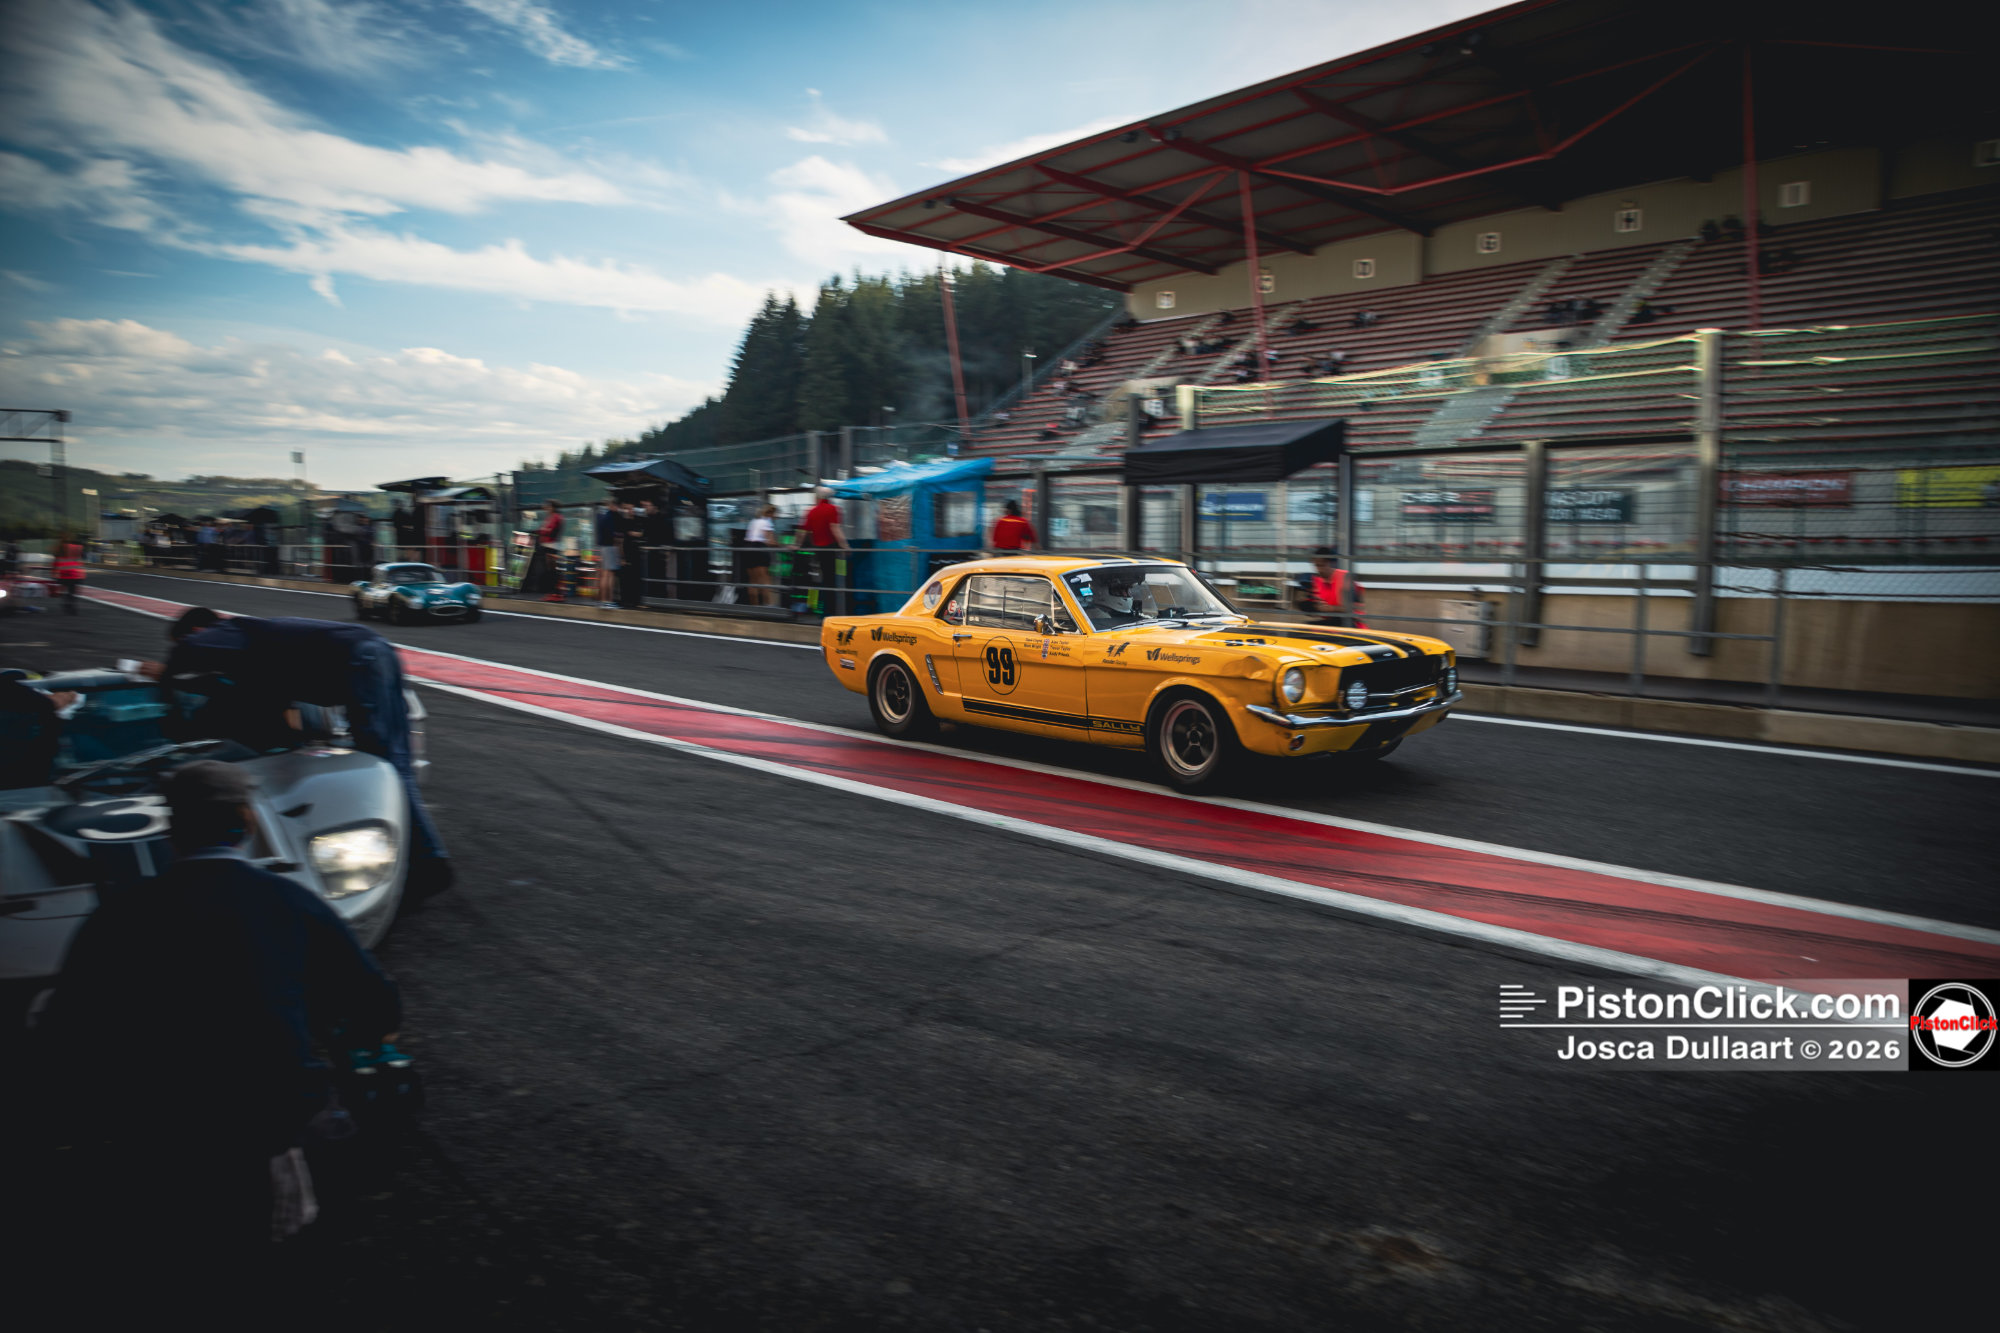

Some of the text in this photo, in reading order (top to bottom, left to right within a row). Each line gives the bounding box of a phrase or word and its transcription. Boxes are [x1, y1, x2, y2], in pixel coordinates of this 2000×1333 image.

[883, 632, 917, 645] Wellsprings
[1160, 653, 1200, 665] Wellsprings
[986, 646, 1015, 686] 99
[1092, 720, 1141, 731] SALLY
